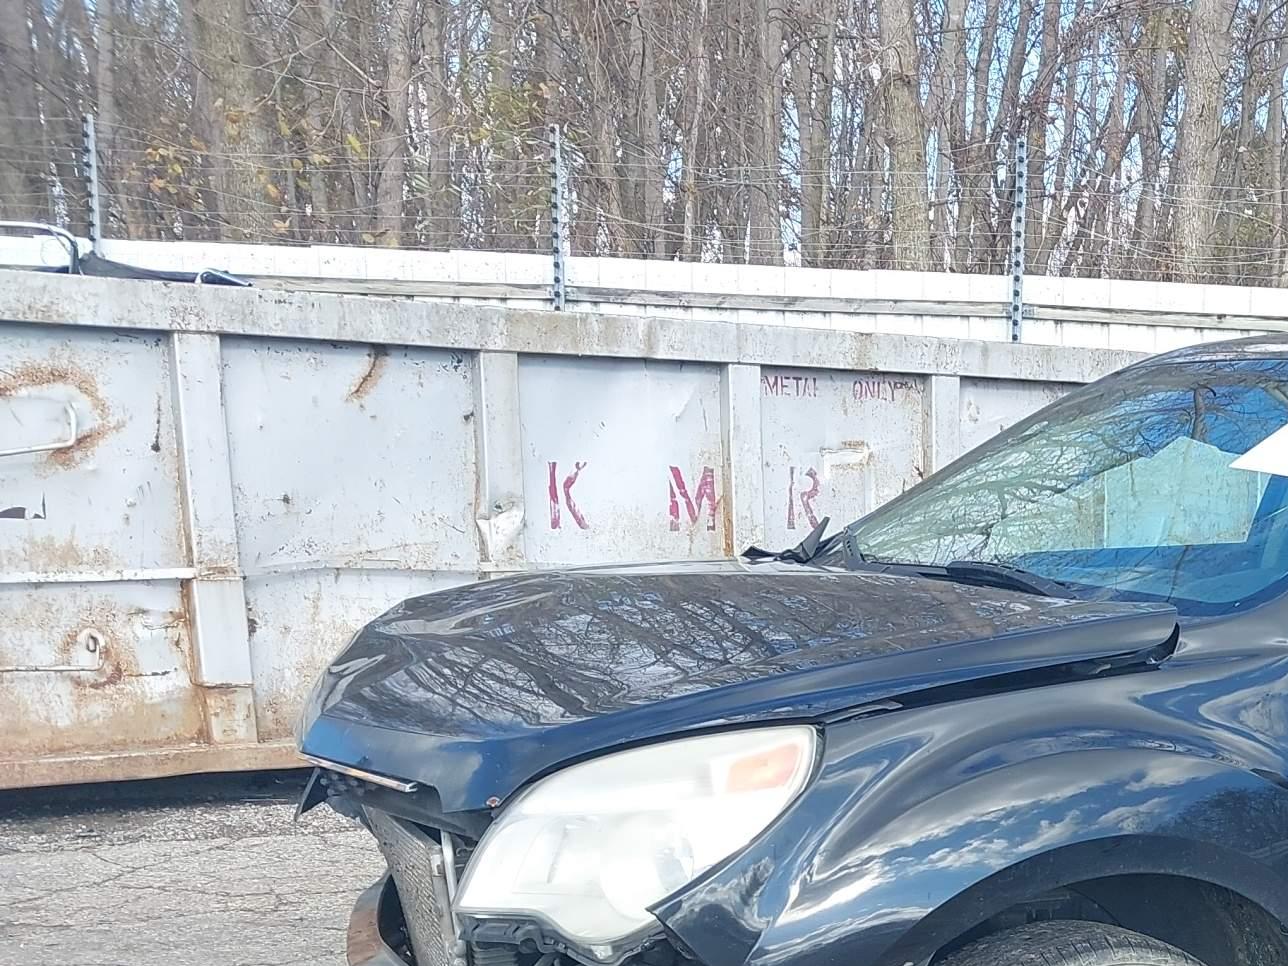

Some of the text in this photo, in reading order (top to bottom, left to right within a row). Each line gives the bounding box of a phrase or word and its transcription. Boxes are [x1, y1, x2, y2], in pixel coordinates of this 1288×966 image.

[852, 380, 897, 402] ONLY
[548, 461, 821, 531] K M R
